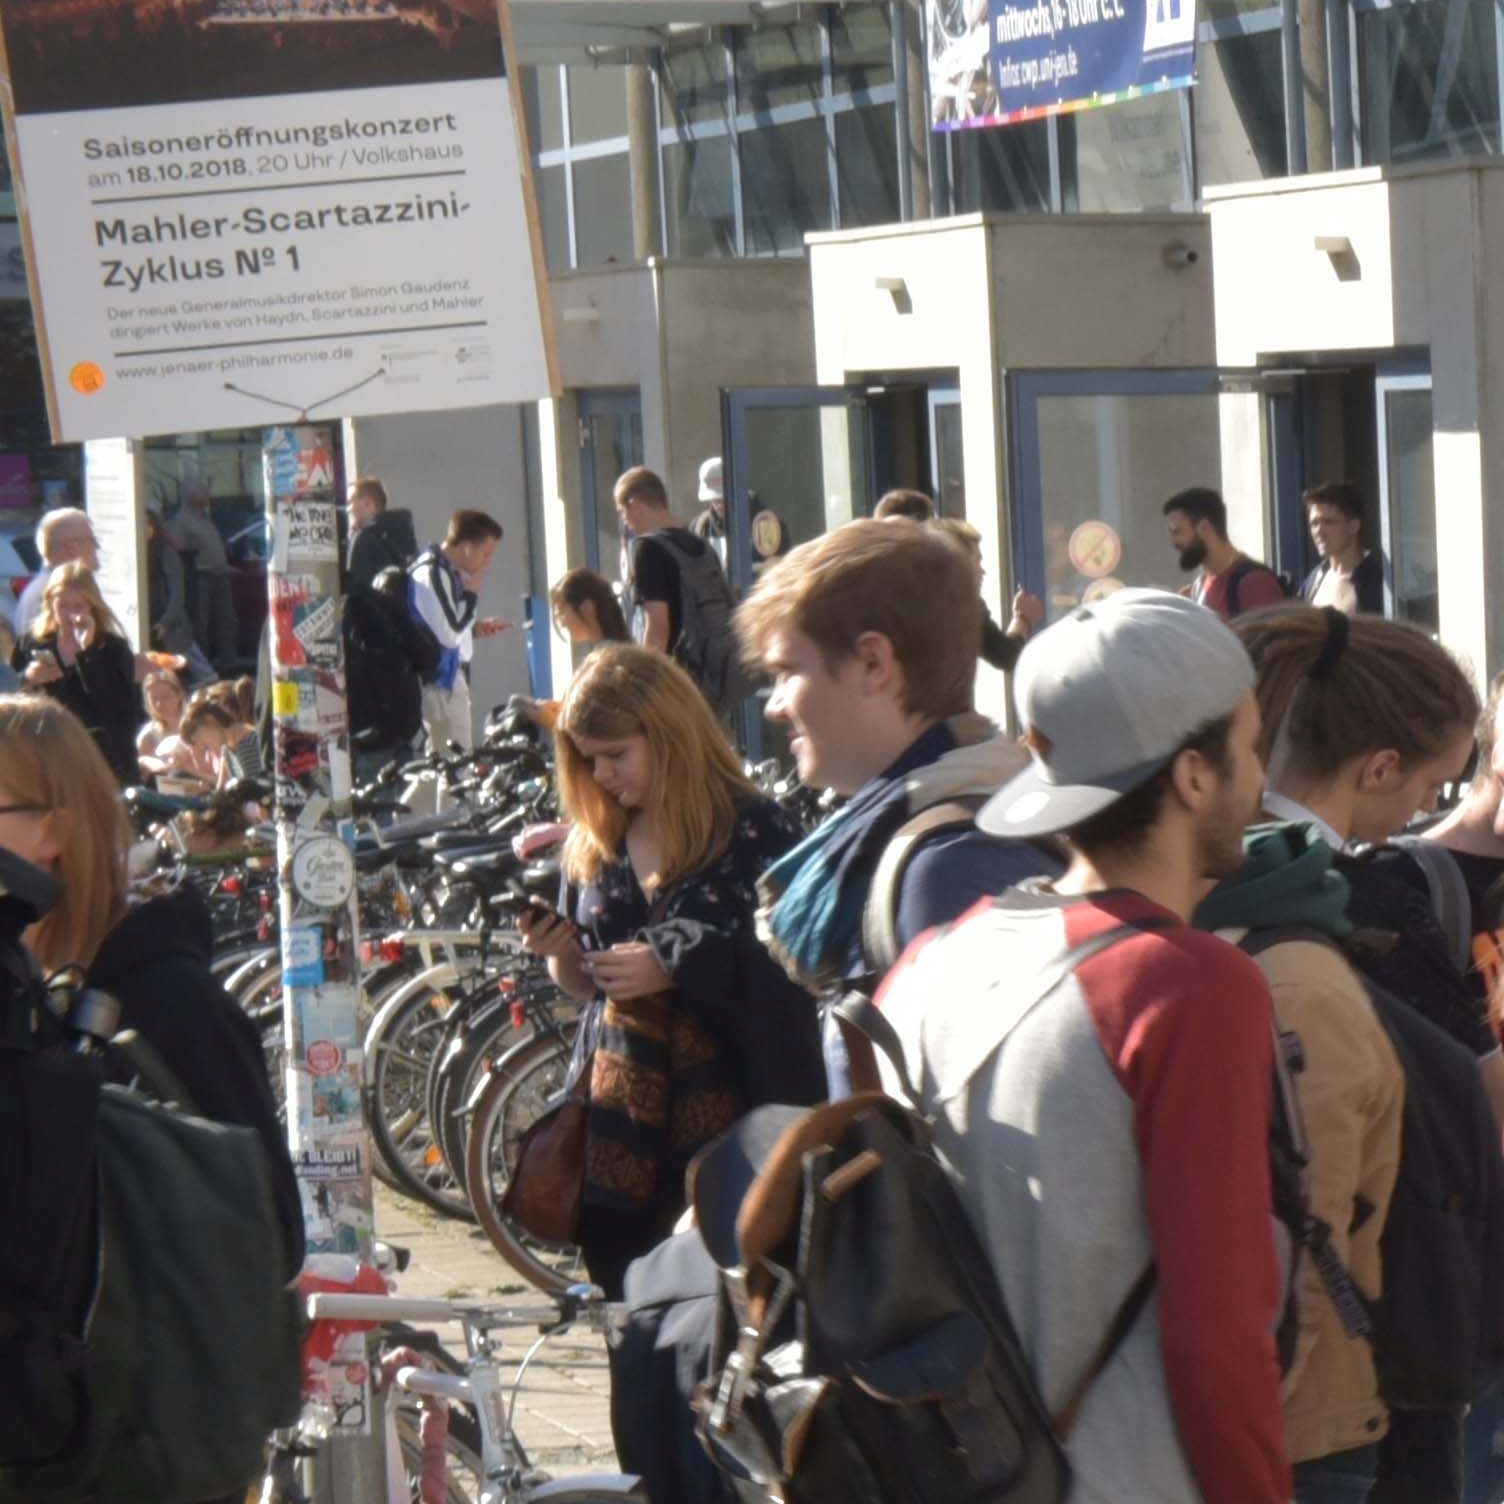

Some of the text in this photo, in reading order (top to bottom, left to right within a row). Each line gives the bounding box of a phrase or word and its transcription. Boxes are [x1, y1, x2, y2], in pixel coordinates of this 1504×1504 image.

[83, 113, 456, 160] Saisoneröffnungskonzert
[89, 171, 122, 187] am
[257, 155, 289, 173] 20
[294, 151, 334, 171] Uhr
[339, 150, 347, 169] /
[352, 143, 464, 167] Volkshaus
[94, 191, 471, 247] Mahler-Scartazzini-
[101, 255, 225, 293] Zyklus
[286, 246, 300, 271] 1
[107, 278, 471, 321] Der neue Generalmusikdirektor Simon Gaudenz
[110, 321, 169, 339] dirigiert
[172, 317, 220, 334] Werke
[224, 317, 252, 330] von
[311, 303, 398, 323] Scartazzini
[401, 299, 429, 314] und
[432, 294, 484, 312] Mahler
[115, 346, 353, 380] www.jenaer-philharmonie.de
